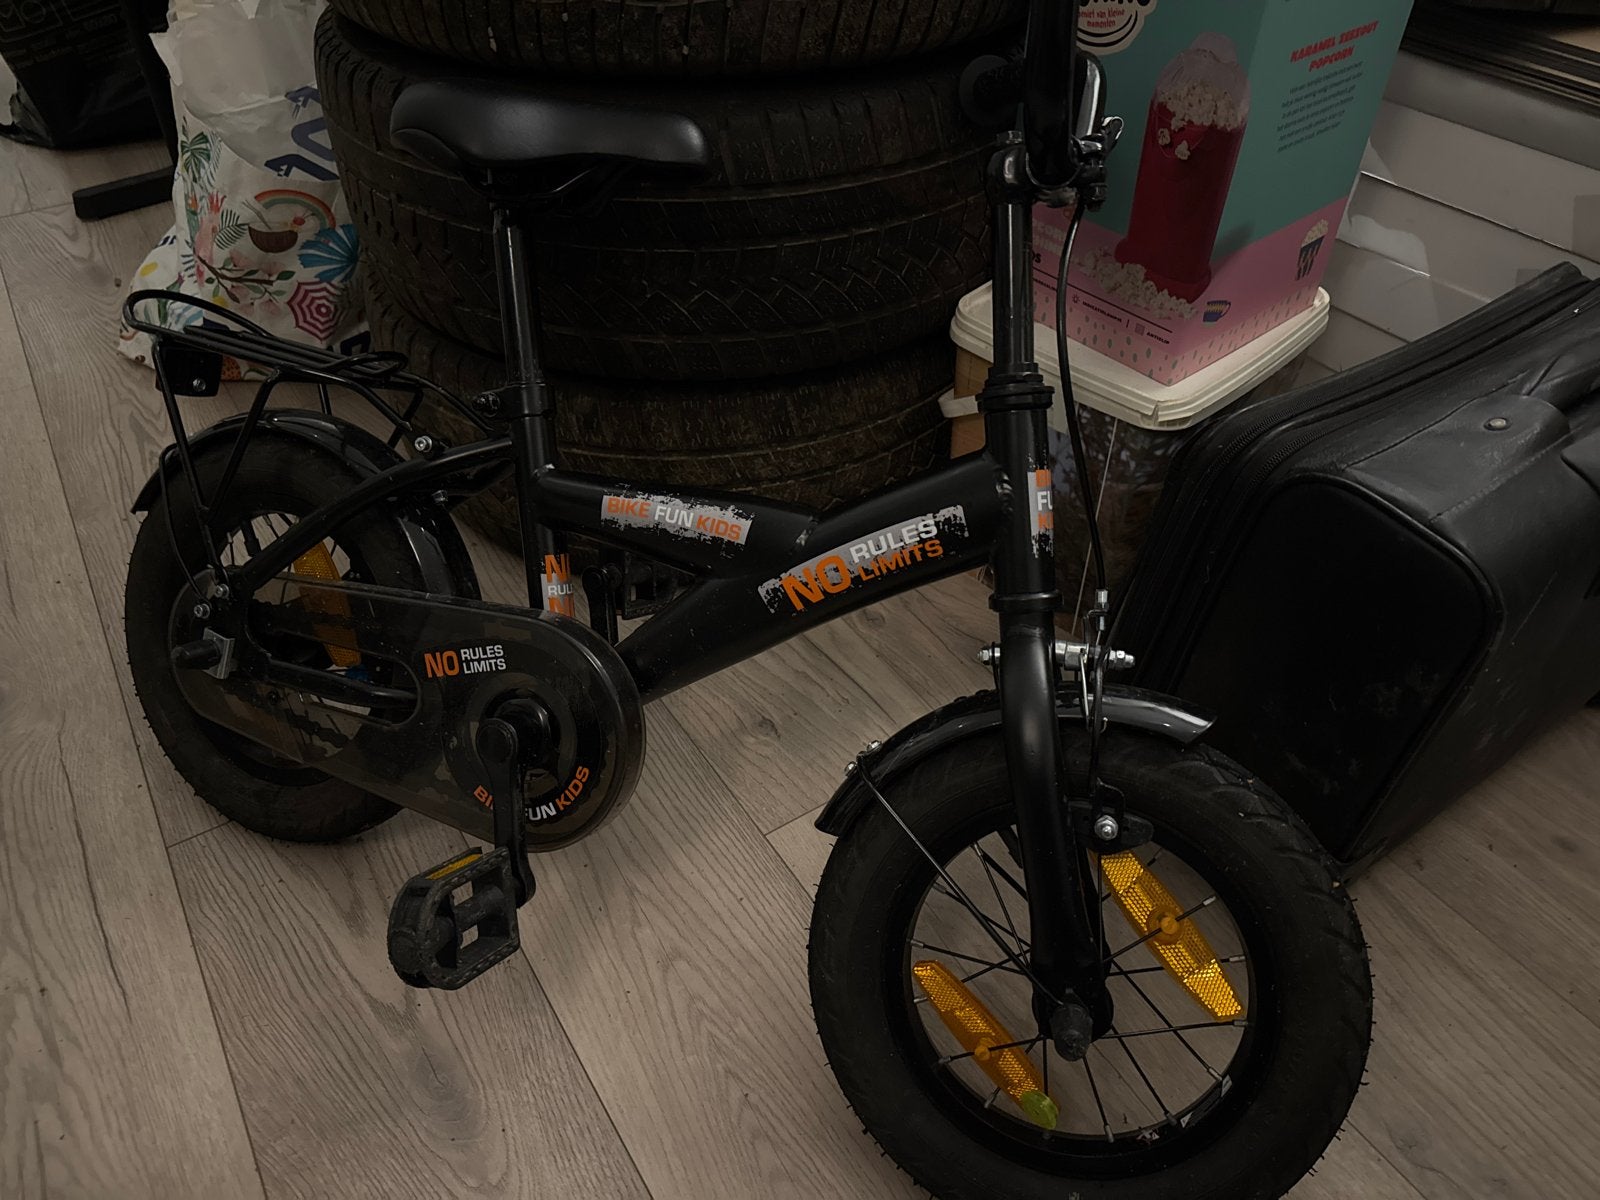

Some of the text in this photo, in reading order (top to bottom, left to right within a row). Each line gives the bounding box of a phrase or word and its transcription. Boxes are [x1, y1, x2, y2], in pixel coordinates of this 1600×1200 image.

[607, 497, 742, 541] BIKE FUN KIDS
[781, 519, 938, 612] NO RULES
[857, 539, 945, 582] LIMITS
[423, 644, 504, 678] NO RULES
[462, 658, 507, 674] LIMITS
[525, 802, 557, 821] UN
[555, 765, 591, 811] KIDS
